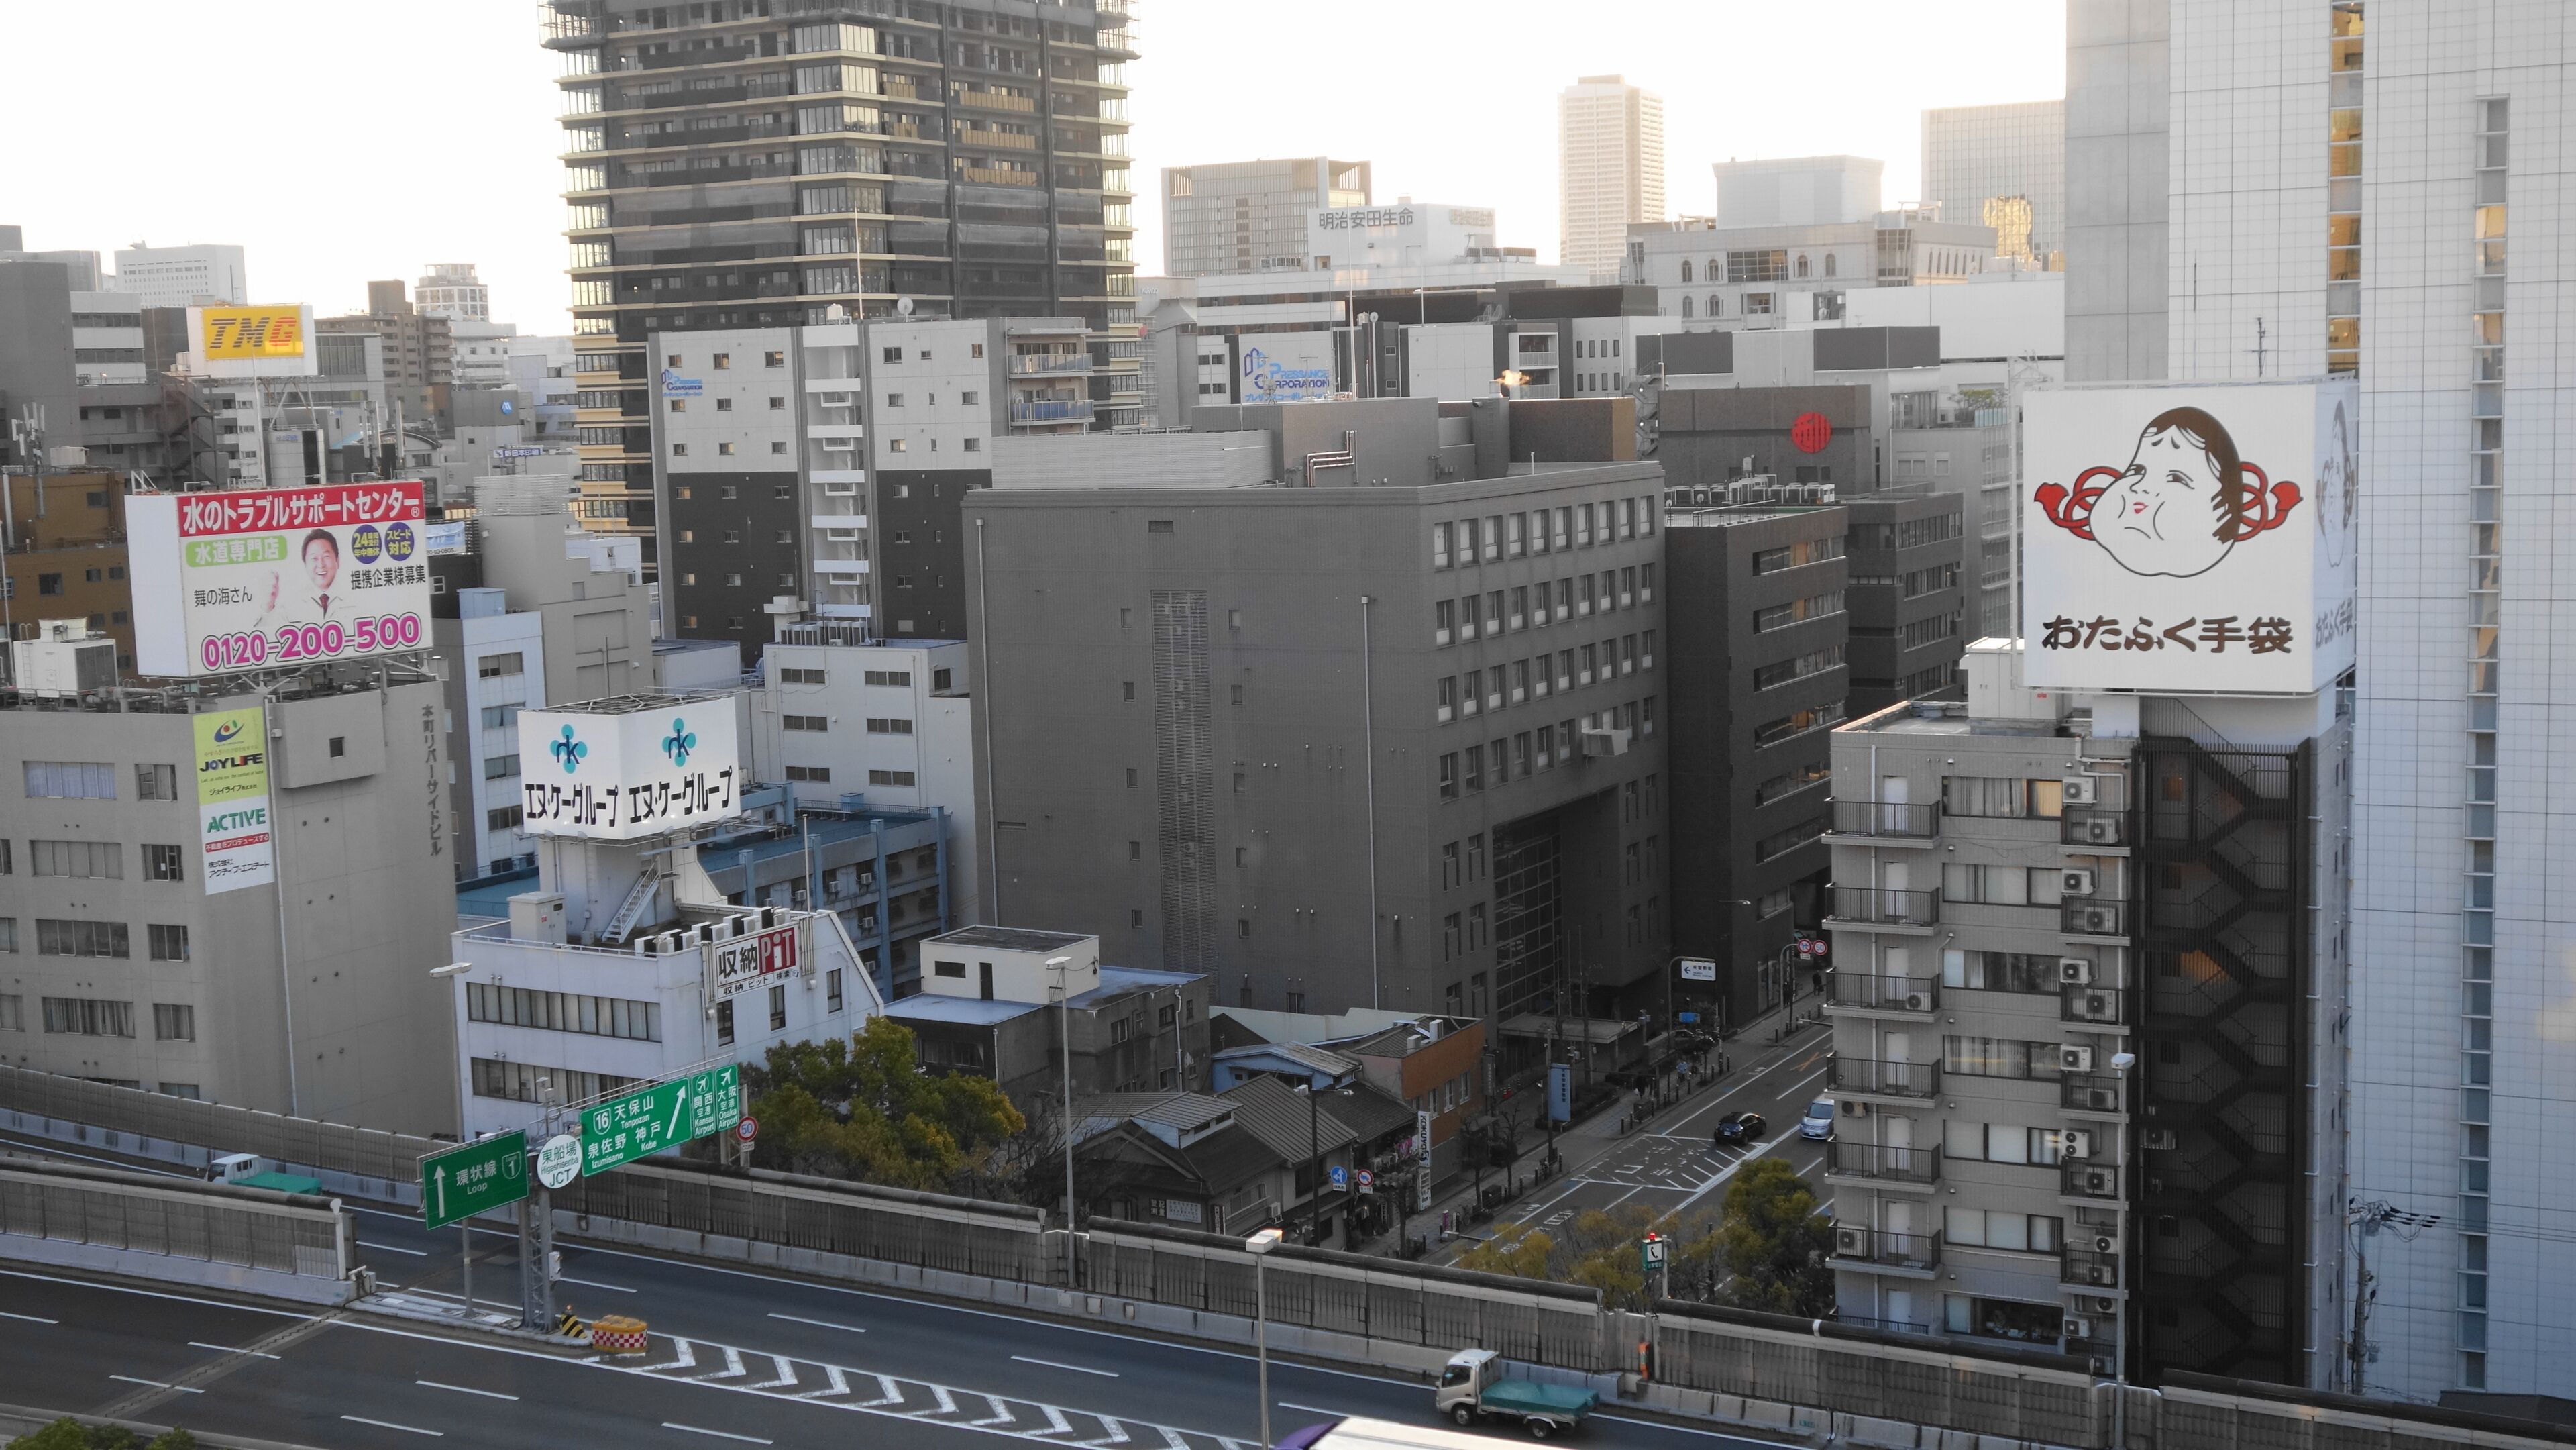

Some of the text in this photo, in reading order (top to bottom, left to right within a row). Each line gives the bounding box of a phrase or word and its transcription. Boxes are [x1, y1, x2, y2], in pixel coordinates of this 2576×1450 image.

[1318, 207, 1414, 230] 明治安田生命
[209, 316, 297, 348] TMG
[1254, 373, 1330, 389] CRPORATION
[182, 487, 420, 535] 水のトラブルサポートセンター
[386, 528, 412, 541] スピード
[194, 537, 280, 565] 水道専門店
[388, 541, 411, 556] 対応
[350, 564, 426, 590] 提携企業様募集
[193, 586, 253, 607] 舞の海さん
[201, 611, 422, 671] 0120-200-500
[2041, 614, 2294, 654] おたふく手袋
[421, 703, 443, 857] 本町リバーサイドビル
[628, 764, 733, 824] エヌ・ケーグループ
[525, 782, 619, 827] エヌ・ケーグループ
[207, 807, 266, 833] ACTIVE
[1815, 943, 1824, 951] 50
[718, 943, 758, 979] 収納
[776, 970, 790, 980] 検索
[694, 1092, 713, 1109] 関西
[718, 1085, 737, 1102] 大阪
[614, 1095, 655, 1121] 天保山
[696, 1105, 711, 1118] 空港
[718, 1108, 737, 1119] Osaka
[720, 1099, 735, 1111] 空港
[595, 1114, 609, 1130] 16
[621, 1114, 650, 1129] Tenpozan
[694, 1115, 714, 1127] Kansai
[694, 1123, 714, 1136] Airport
[718, 1115, 738, 1129] Airport
[741, 1123, 753, 1135] 50
[588, 1121, 661, 1159] 泉佐野 神戸
[542, 1141, 577, 1165] 東船場
[591, 1141, 657, 1169] Izumisano Kobe
[456, 1159, 497, 1187] 環状線
[508, 1161, 515, 1176] 1
[541, 1156, 578, 1175] Higashisenba
[549, 1168, 572, 1188] JCT
[467, 1182, 488, 1195] Loop
